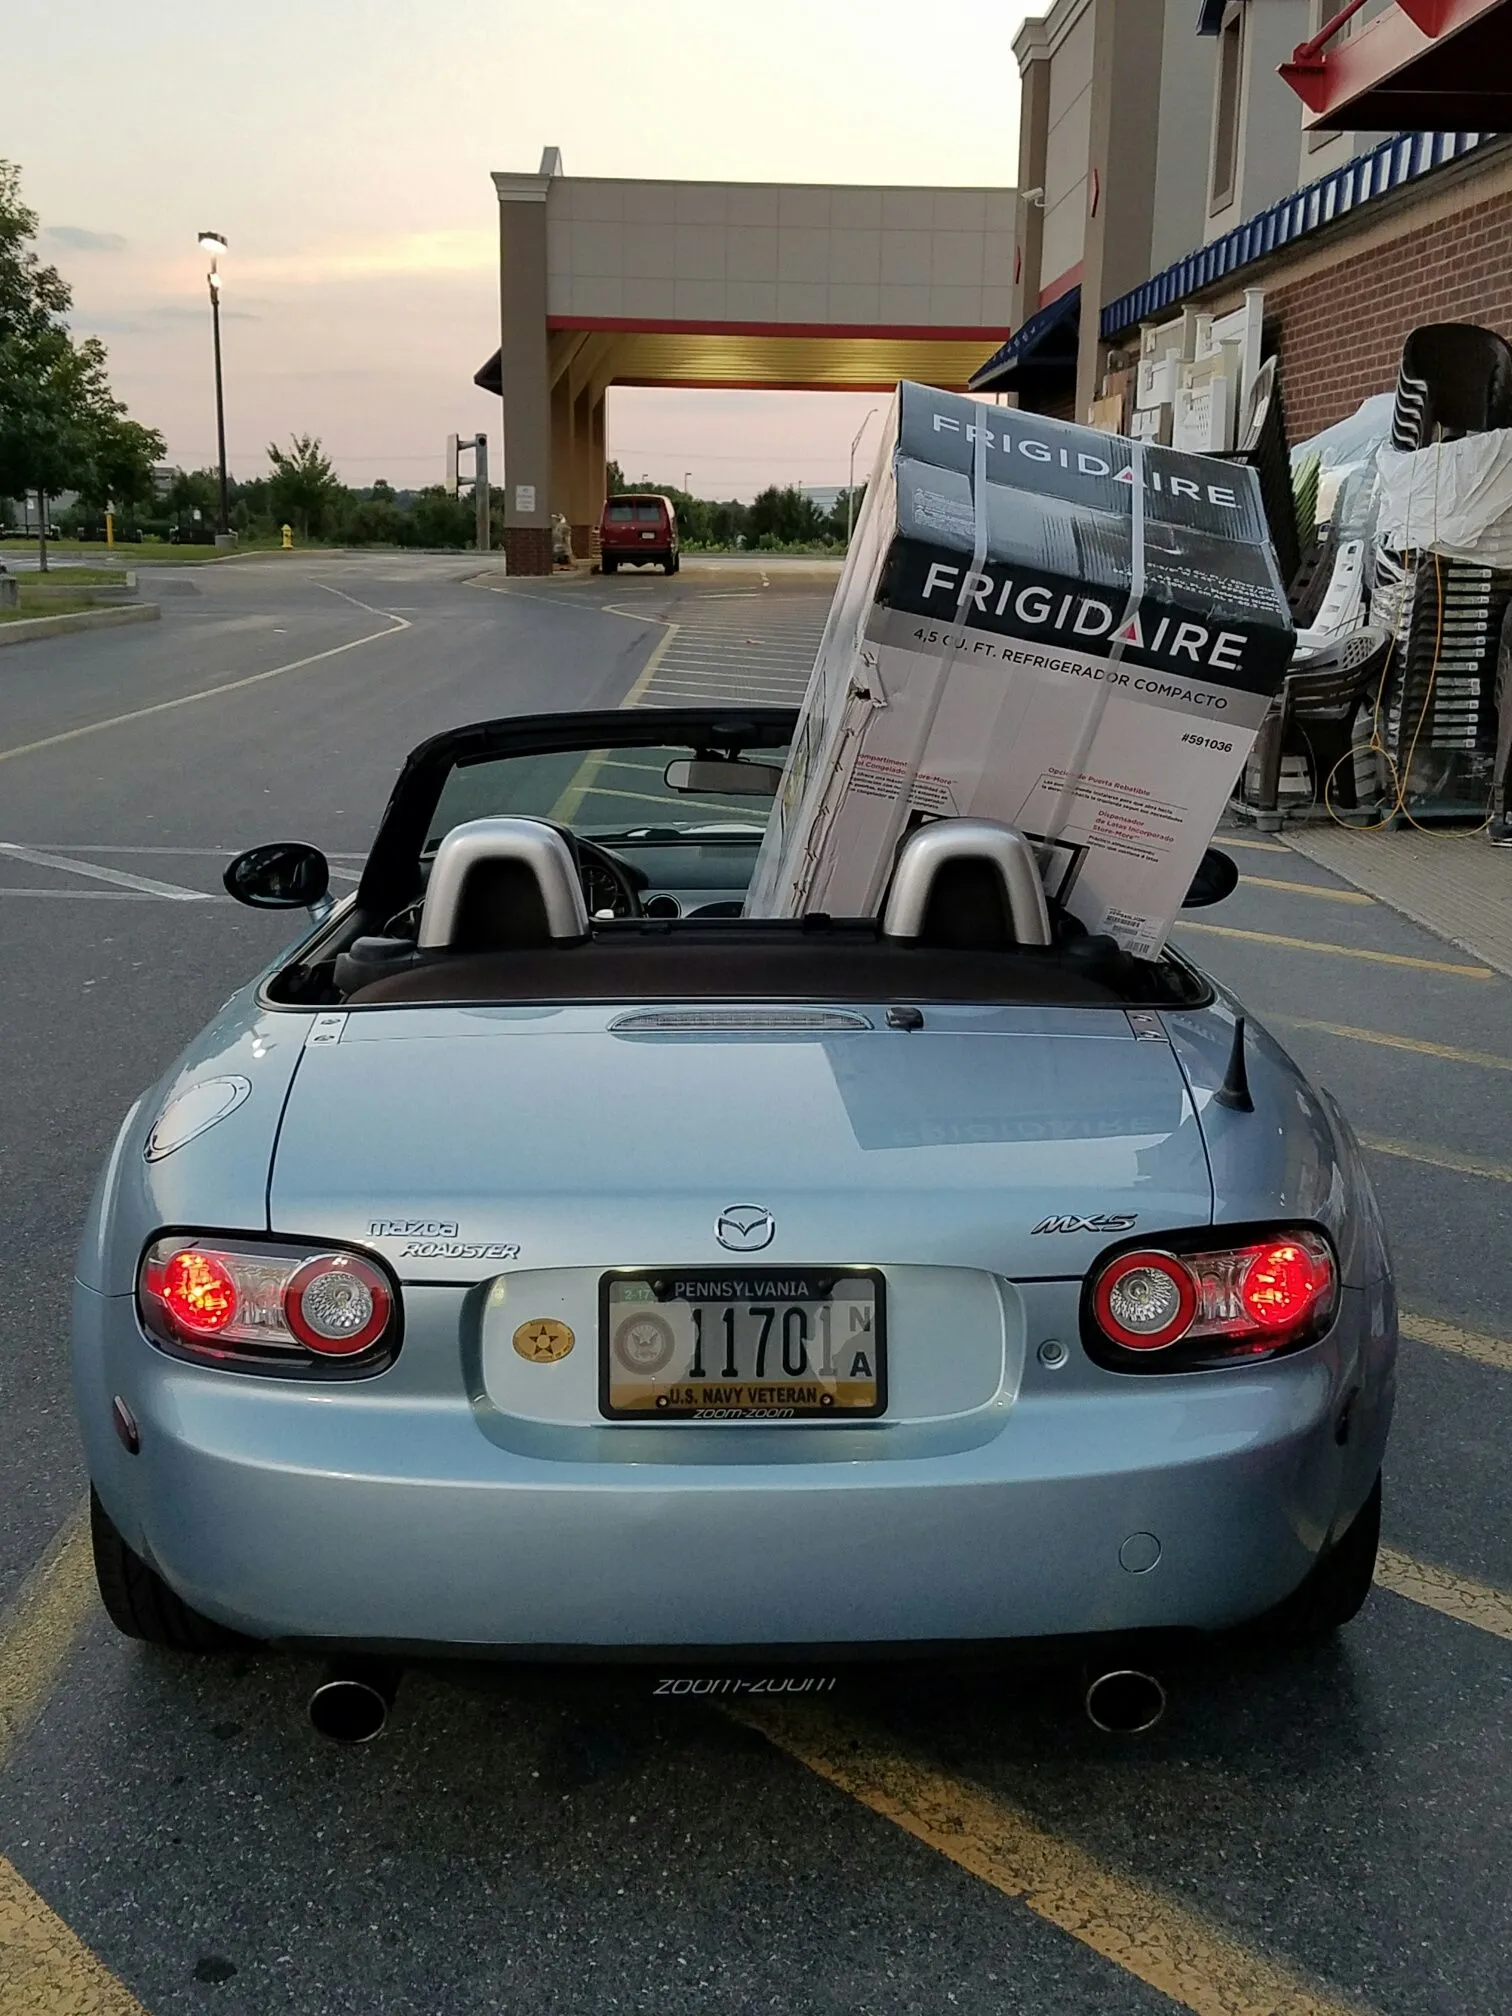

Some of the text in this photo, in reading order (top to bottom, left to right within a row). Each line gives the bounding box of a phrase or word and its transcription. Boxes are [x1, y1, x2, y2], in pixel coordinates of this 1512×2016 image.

[933, 413, 1239, 508] FRIGIDAIRE
[921, 562, 1248, 671] FRIGIDAIRE
[914, 628, 939, 643] 4,5
[973, 641, 997, 658] FT.
[1001, 649, 1130, 687] REFRIGERADOR
[1134, 678, 1229, 710] COMPACTO
[1181, 732, 1233, 754] #591036
[1129, 825, 1175, 843] Incorporado
[1030, 1214, 1139, 1235] MX-5
[400, 1242, 521, 1260] ROADSTER
[674, 1281, 809, 1297] PENNSYLVANIA
[850, 1306, 871, 1332] N
[689, 1306, 838, 1378] 11701
[850, 1351, 873, 1377] A
[669, 1387, 817, 1403] U.S. NAVY VETERAN
